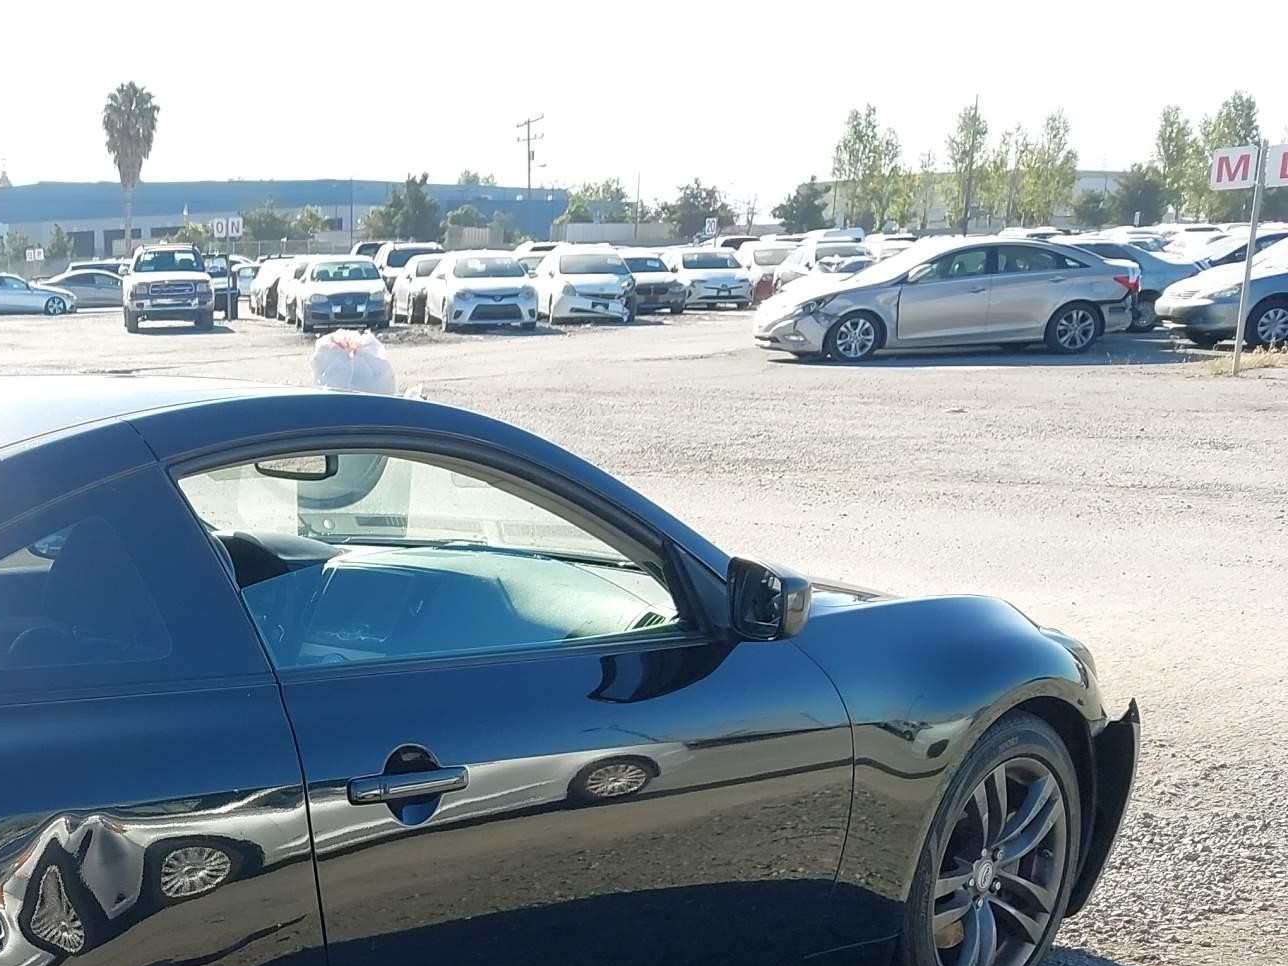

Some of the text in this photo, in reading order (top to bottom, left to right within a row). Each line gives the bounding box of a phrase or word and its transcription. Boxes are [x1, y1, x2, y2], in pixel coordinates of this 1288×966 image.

[1216, 154, 1251, 183] M
[231, 221, 240, 233] N
[706, 220, 716, 233] 20
